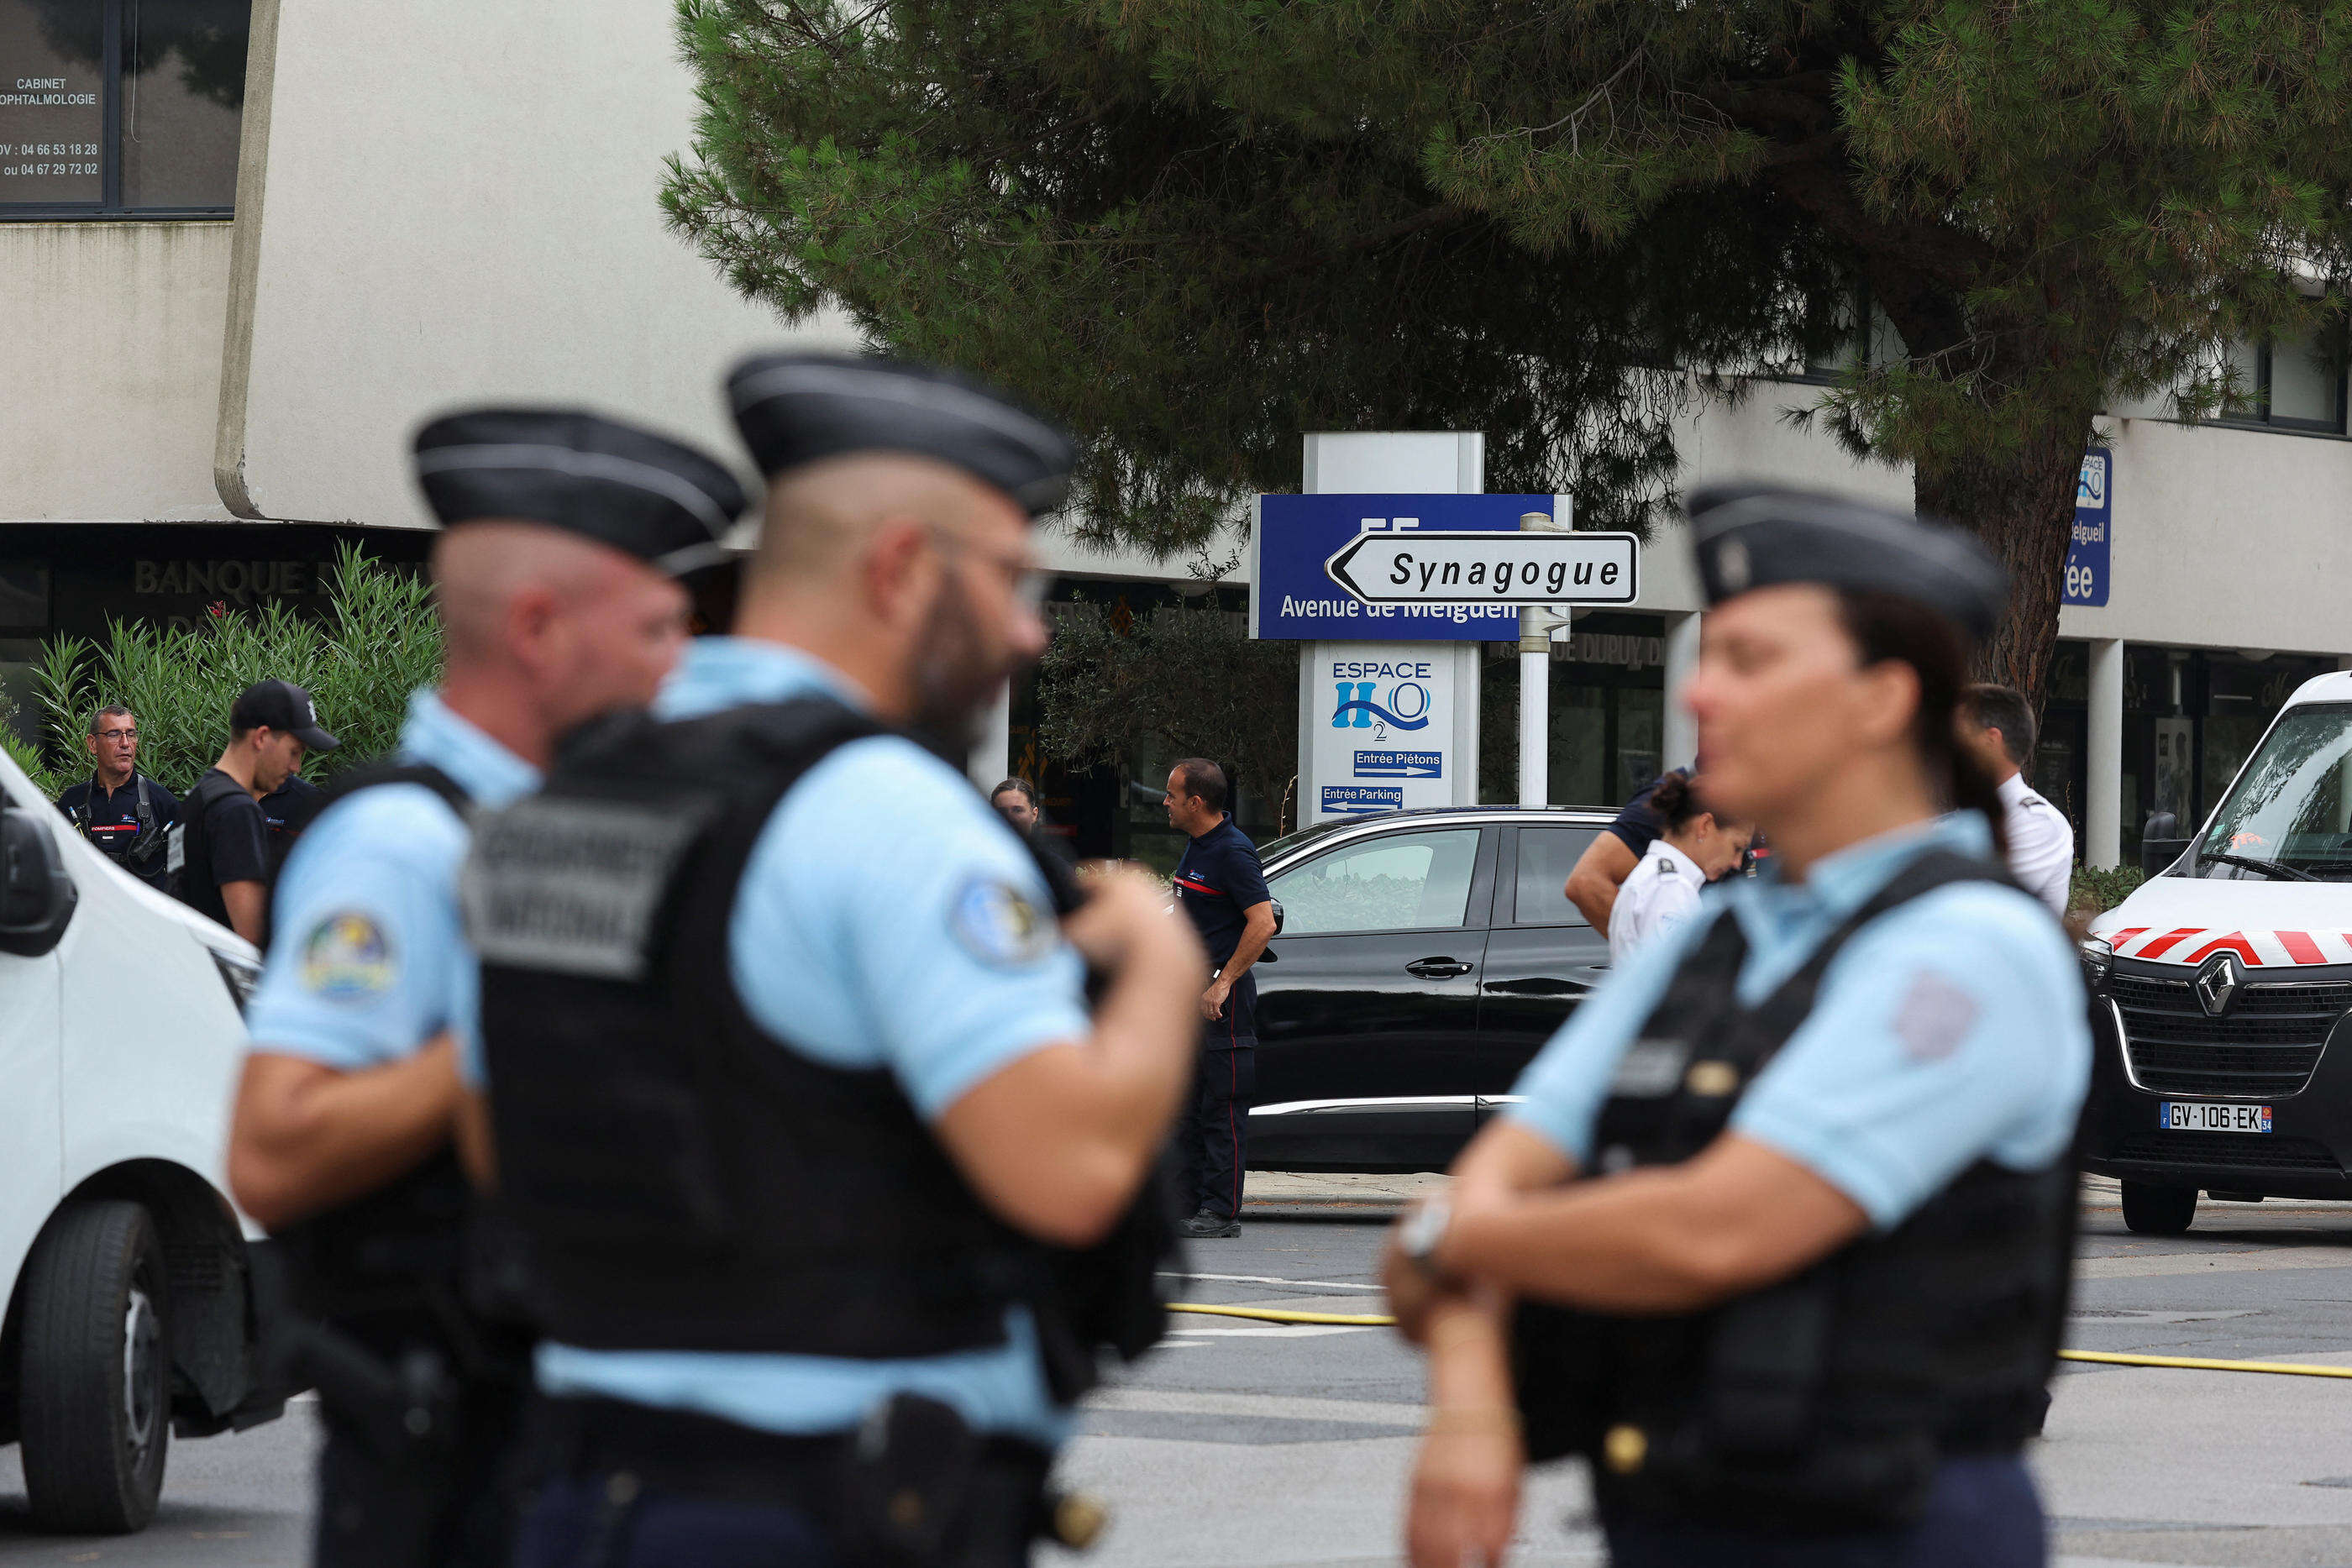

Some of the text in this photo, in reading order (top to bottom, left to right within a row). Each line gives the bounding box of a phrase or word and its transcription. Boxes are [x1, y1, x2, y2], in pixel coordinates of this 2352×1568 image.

[17, 78, 66, 90] CABINET
[0, 93, 96, 105] OPHTALMOLOGIE
[21, 144, 34, 155] 04
[37, 144, 50, 155] 66
[53, 144, 66, 155] 53
[70, 144, 81, 155] 18
[84, 144, 97, 155] 28
[4, 163, 97, 176] ou 04 67 29 72 02
[2071, 520, 2104, 546] elgueil
[1390, 553, 1619, 595] Synagogue
[2064, 554, 2093, 599] ée
[134, 560, 303, 604] BANQUE
[1280, 595, 1359, 618] Avenue
[1333, 662, 1431, 679] ESPACE
[1357, 753, 1440, 765] Entrée Piétons
[1324, 788, 1402, 802] Entrée Parking
[2171, 1105, 2260, 1130] GV-106-EK
[2262, 1120, 2271, 1130] 34
